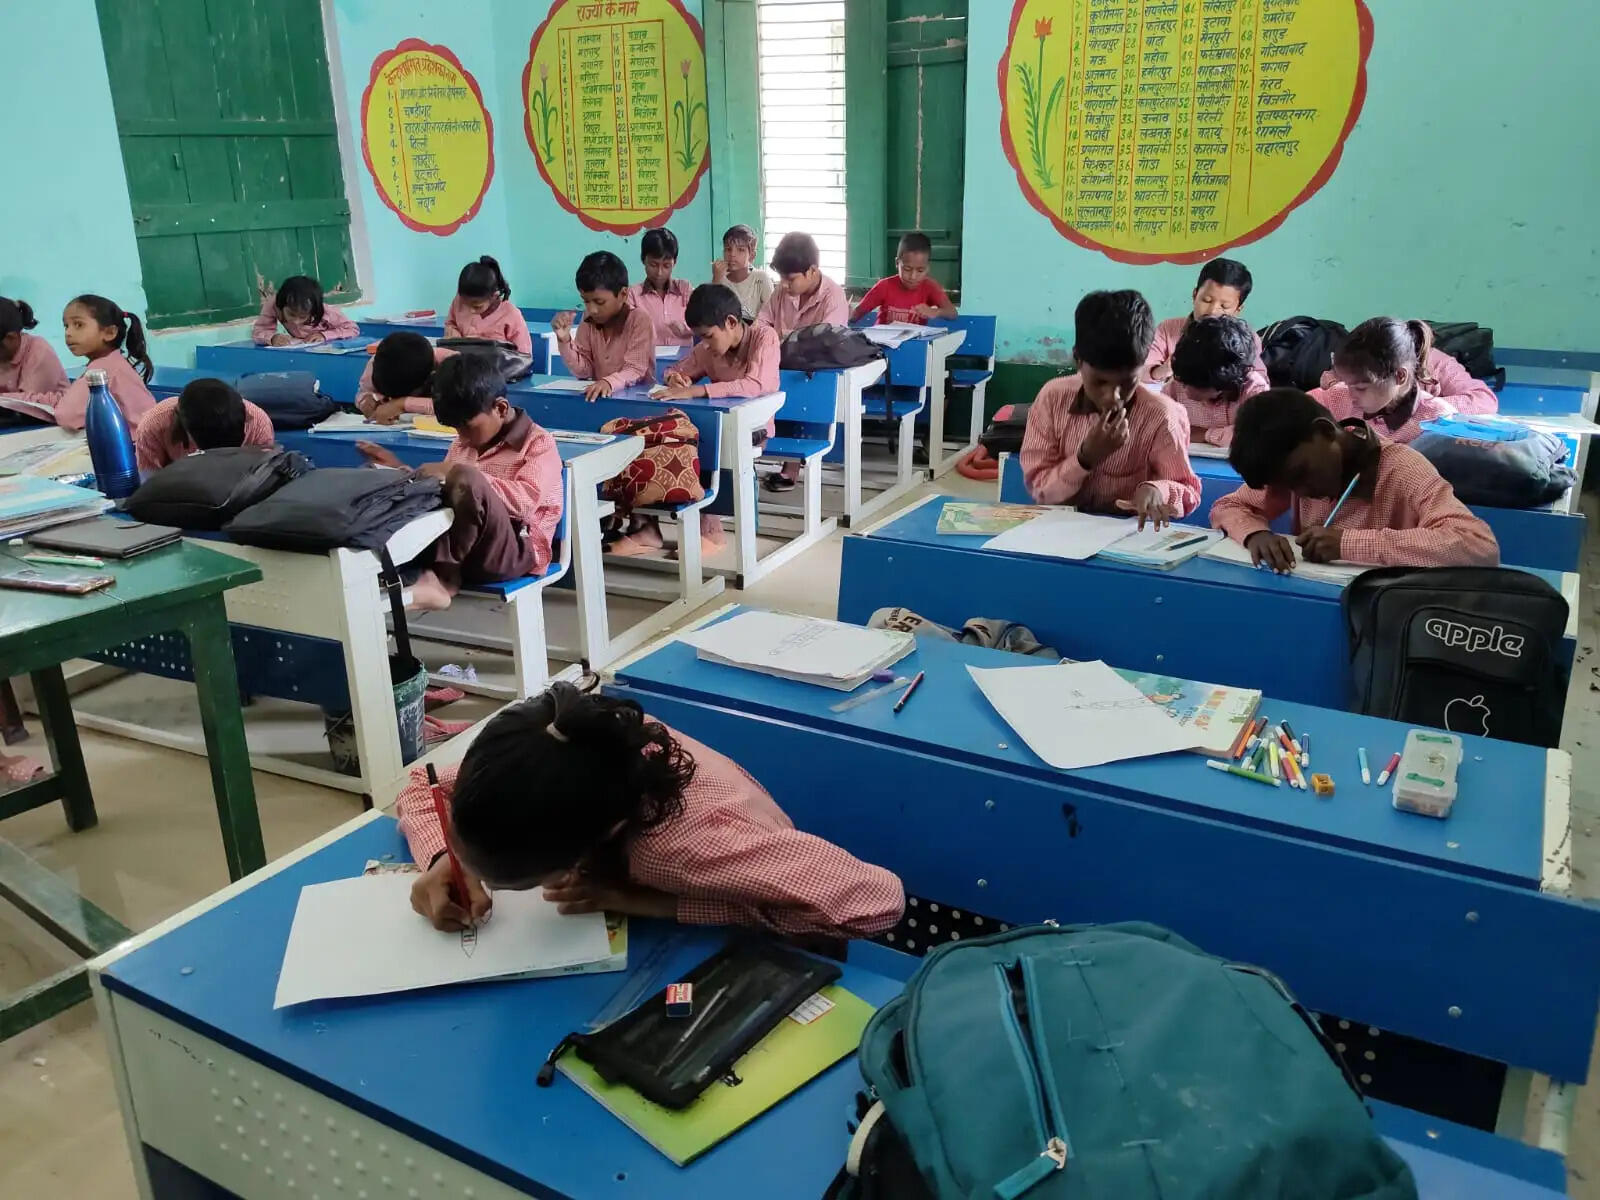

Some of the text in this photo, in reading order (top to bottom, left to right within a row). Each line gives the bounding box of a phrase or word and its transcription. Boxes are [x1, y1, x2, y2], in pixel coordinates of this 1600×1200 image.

[618, 1, 640, 17] नाम
[1256, 140, 1301, 158] सहारनपुर
[1191, 190, 1220, 202] आगरा
[1425, 617, 1526, 658] apple
